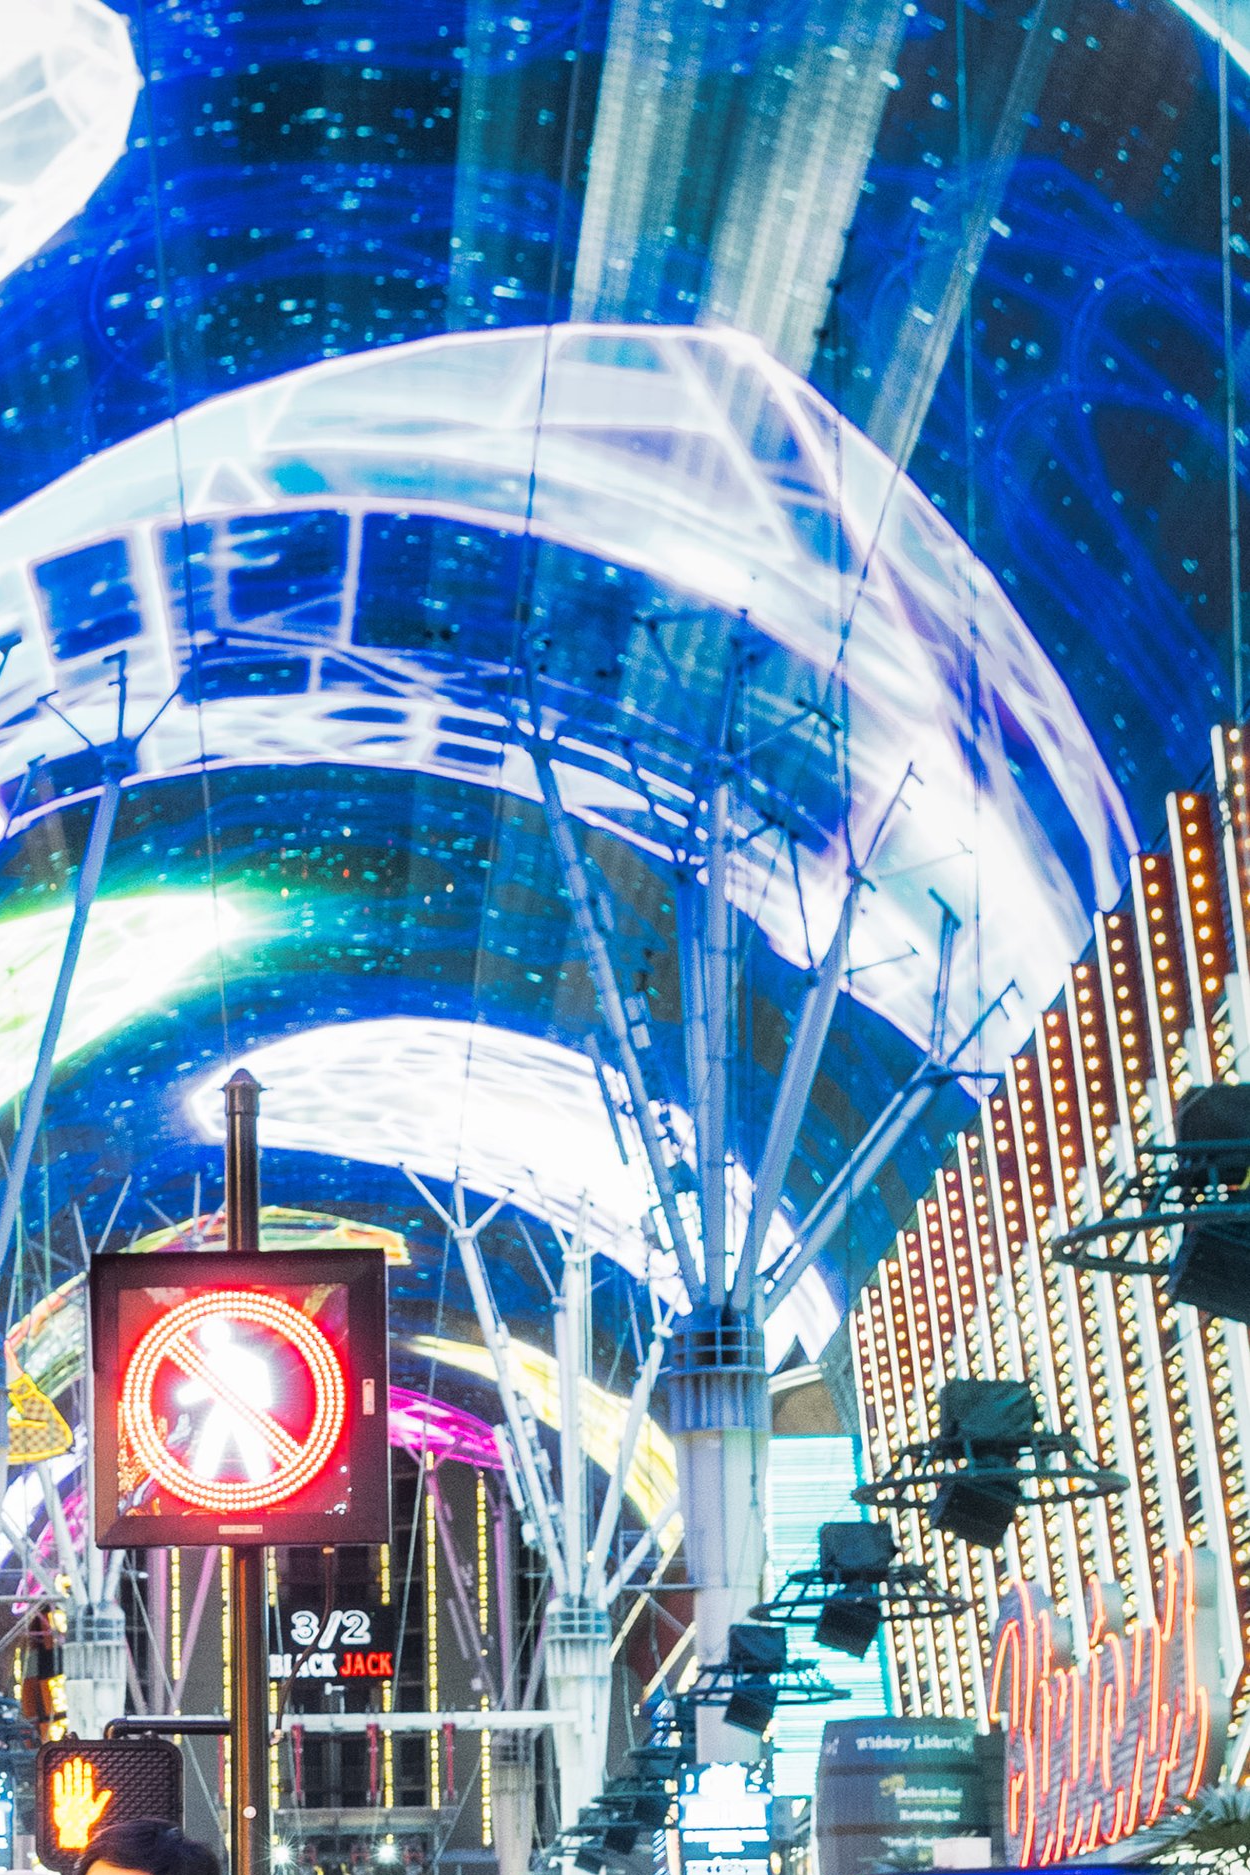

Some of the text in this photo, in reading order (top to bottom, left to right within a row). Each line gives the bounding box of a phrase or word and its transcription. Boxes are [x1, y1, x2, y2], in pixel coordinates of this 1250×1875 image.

[290, 1609, 372, 1650] 3/2
[268, 1651, 394, 1678] BLACK JACK
